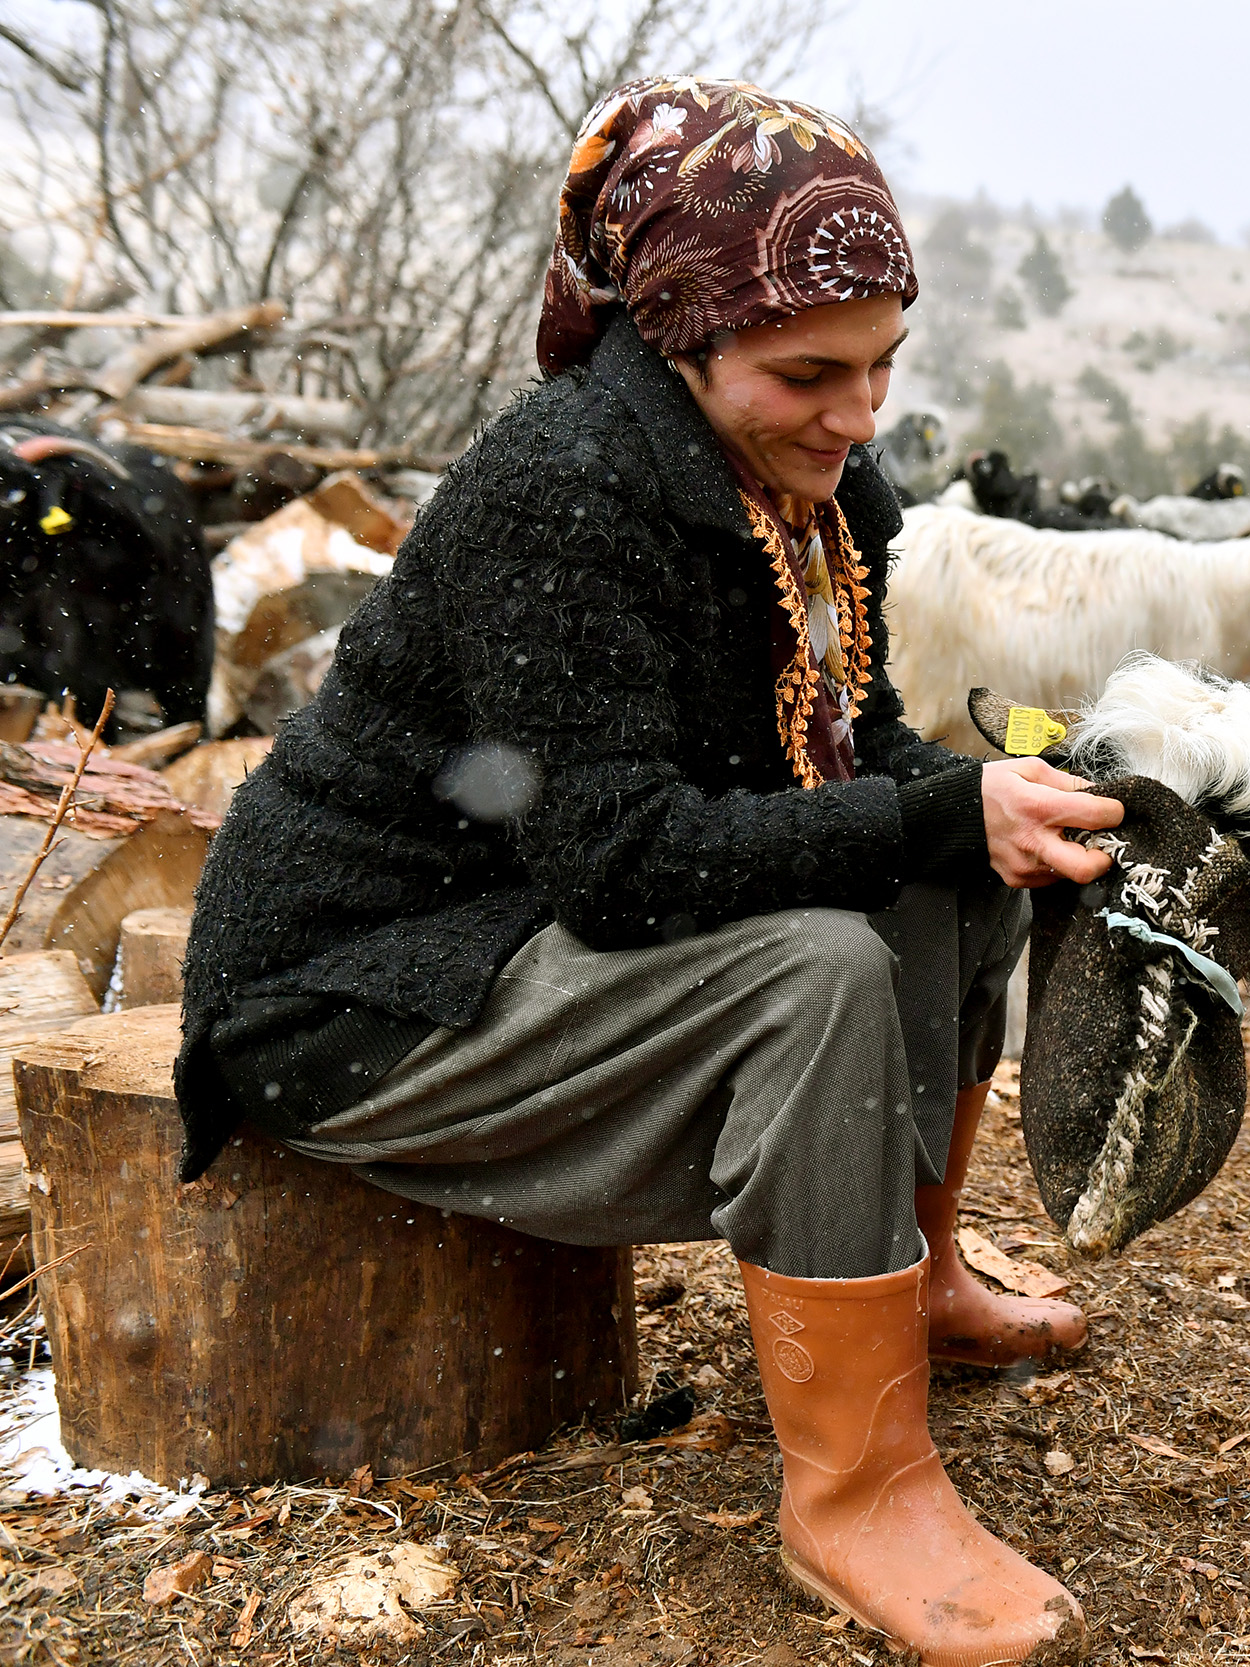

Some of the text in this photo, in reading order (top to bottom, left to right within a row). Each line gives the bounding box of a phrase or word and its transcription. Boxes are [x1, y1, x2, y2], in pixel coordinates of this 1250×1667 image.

[1010, 708, 1031, 750] 6164103
[1031, 712, 1045, 749] TR 33
